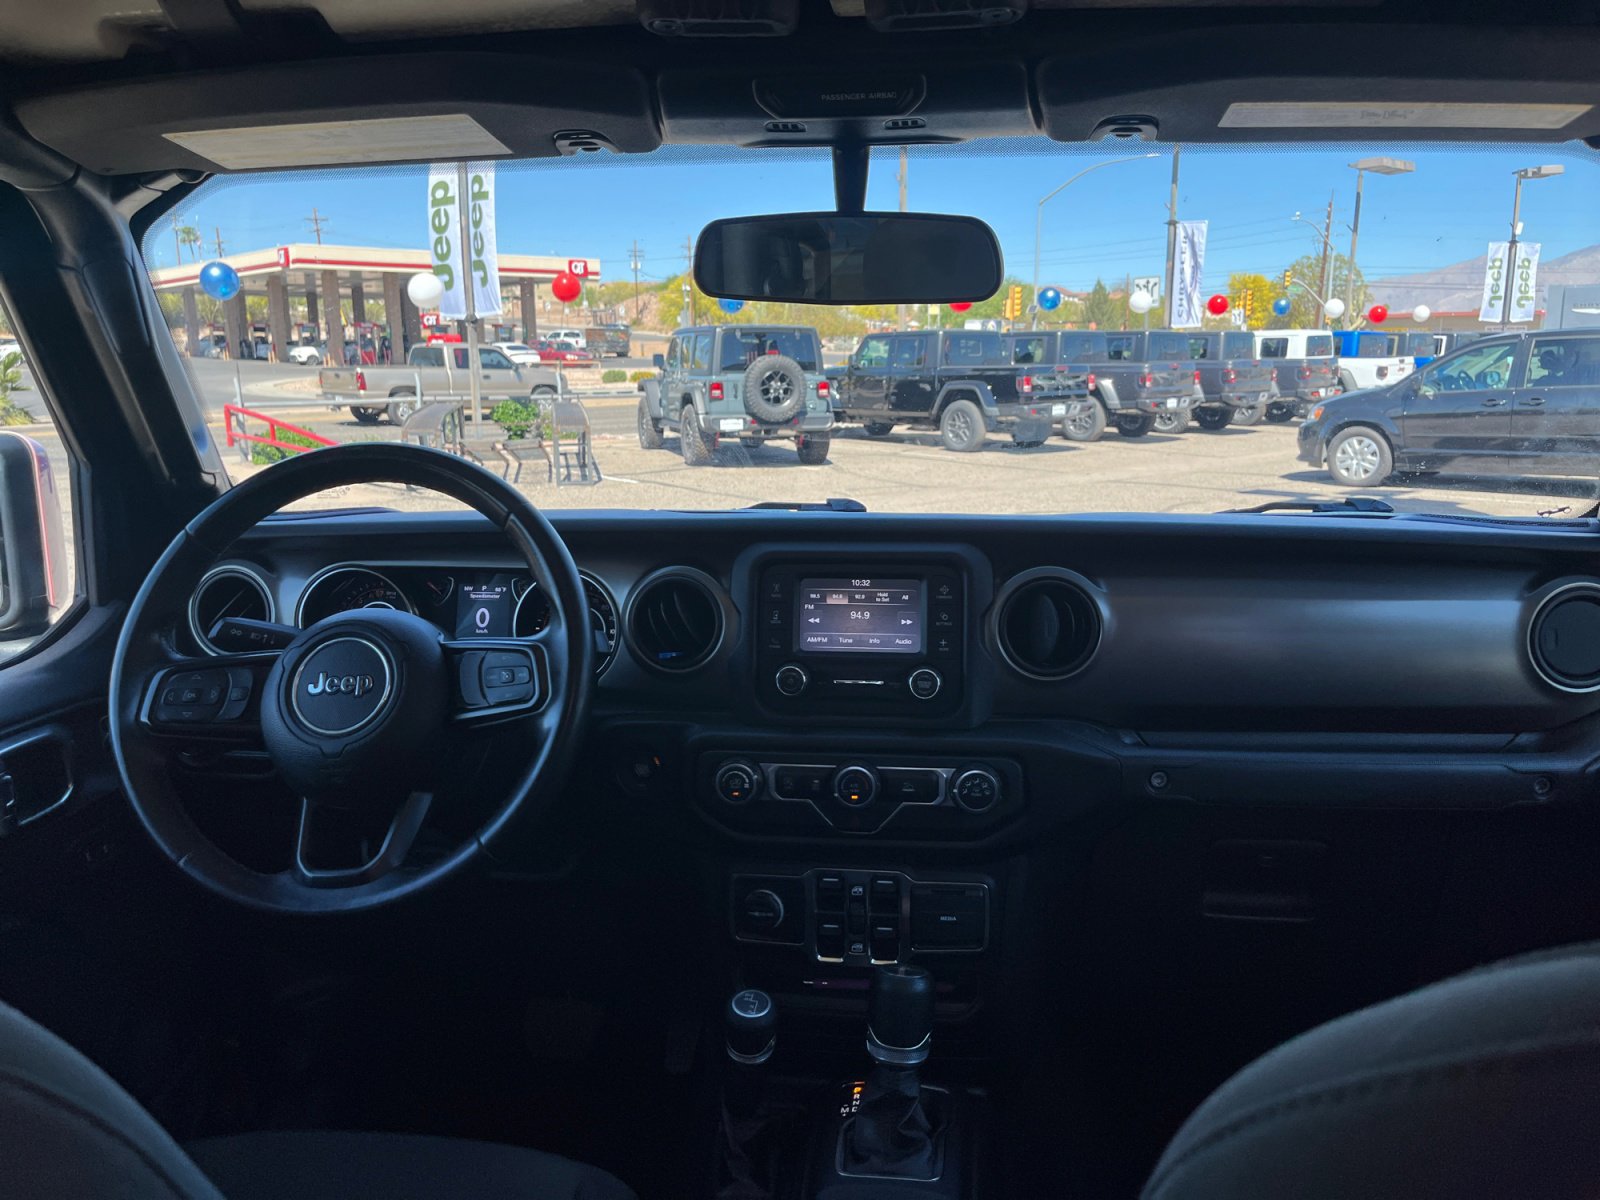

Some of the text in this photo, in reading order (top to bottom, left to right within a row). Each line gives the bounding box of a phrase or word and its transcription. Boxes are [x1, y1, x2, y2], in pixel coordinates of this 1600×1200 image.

[821, 91, 897, 101] PASSENGER AIRBAG
[431, 181, 455, 291] Jeep
[471, 174, 489, 288] Jeep
[1177, 235, 1188, 318] CHRYSLER
[851, 579, 871, 587] 10:32
[475, 607, 490, 628] 0
[850, 611, 871, 620] 94.9
[307, 671, 374, 697] Jeep
